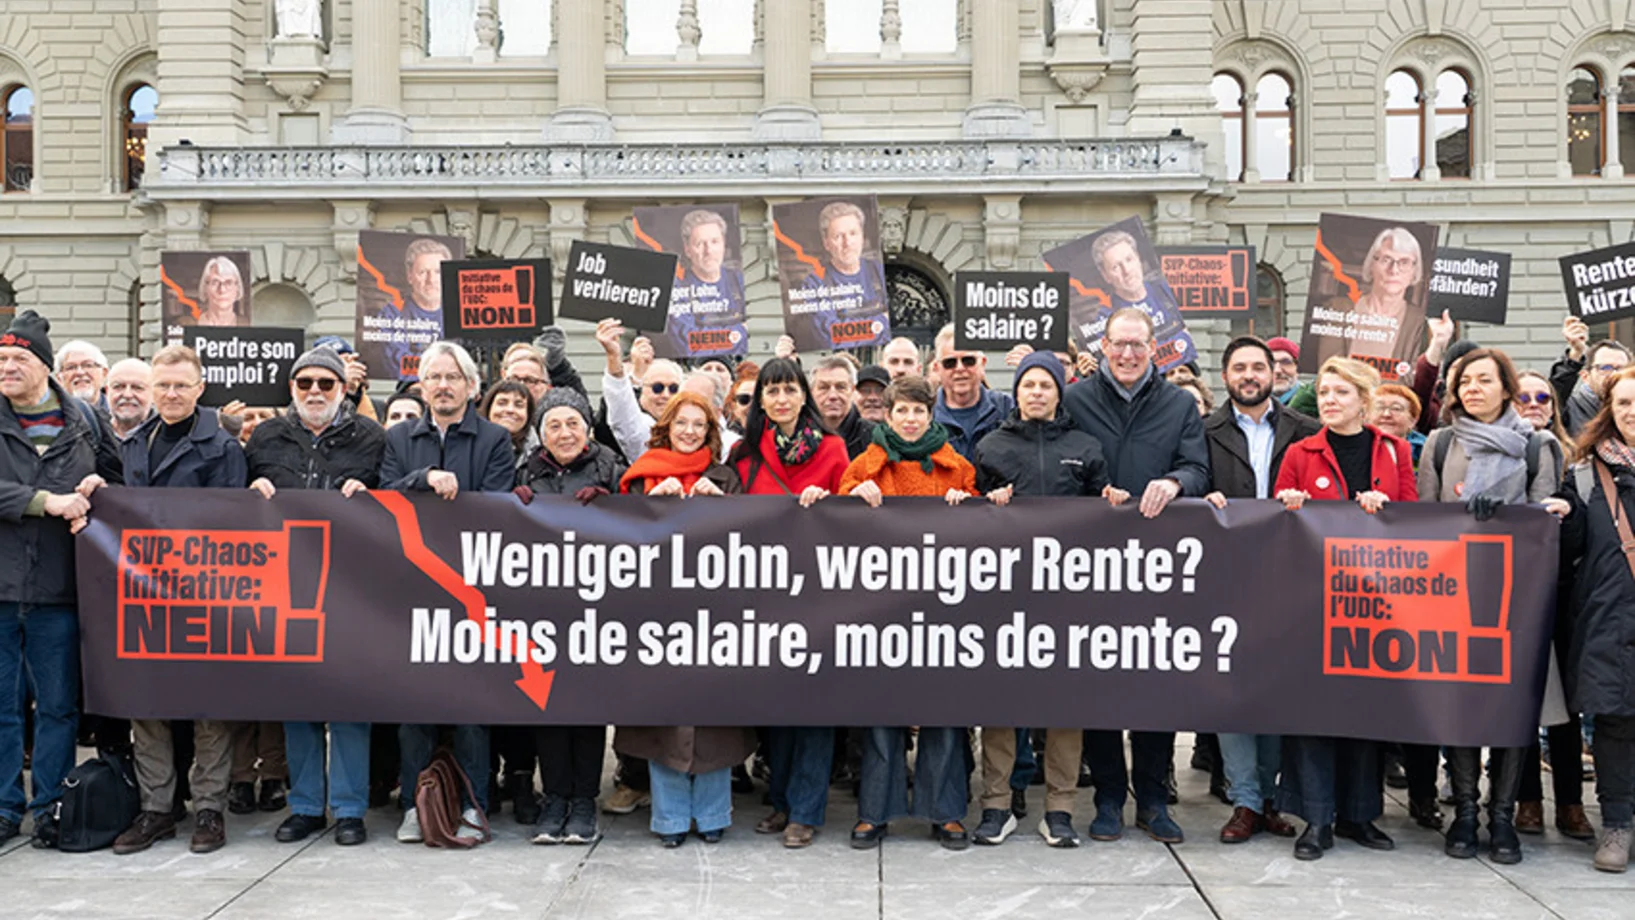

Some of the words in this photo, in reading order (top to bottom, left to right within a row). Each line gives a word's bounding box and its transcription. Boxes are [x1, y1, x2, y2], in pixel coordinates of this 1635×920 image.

[576, 252, 606, 275] Job
[1164, 258, 1227, 270] SVP-Chaos-
[1433, 258, 1499, 278] sundheit
[461, 273, 501, 283] Initiative
[463, 284, 472, 293] du
[474, 284, 501, 293] chaos
[502, 282, 513, 293] de
[1429, 274, 1497, 297] fährden?
[573, 278, 661, 308] verlieren?
[966, 281, 1029, 308] Moins
[1032, 281, 1059, 308] de
[363, 315, 391, 328] Moins
[393, 316, 405, 328] de
[964, 312, 1037, 340] salaire
[1312, 306, 1344, 322] Moins
[1345, 310, 1359, 324] de
[362, 330, 391, 342] moins
[394, 330, 405, 342] de
[1309, 322, 1343, 338] moins
[1344, 325, 1357, 340] de
[1358, 329, 1387, 342] rente
[195, 336, 258, 359] Perdre
[261, 342, 295, 359] son
[127, 535, 277, 566] SVP-Chaos-
[1331, 545, 1429, 569] Initiative
[460, 531, 660, 600] Weniger
[671, 533, 804, 596] Lohn,
[816, 533, 1021, 605] weniger
[1032, 536, 1203, 593] Rente?
[124, 568, 261, 601] Initiative:
[1331, 570, 1357, 593] du
[1362, 571, 1427, 595] chaos
[1431, 573, 1457, 596] de
[410, 607, 557, 664] Moins
[568, 608, 627, 665] de
[638, 609, 822, 674] salaire,
[835, 612, 985, 668] moins
[996, 612, 1056, 669] de
[1068, 616, 1201, 671] rente
